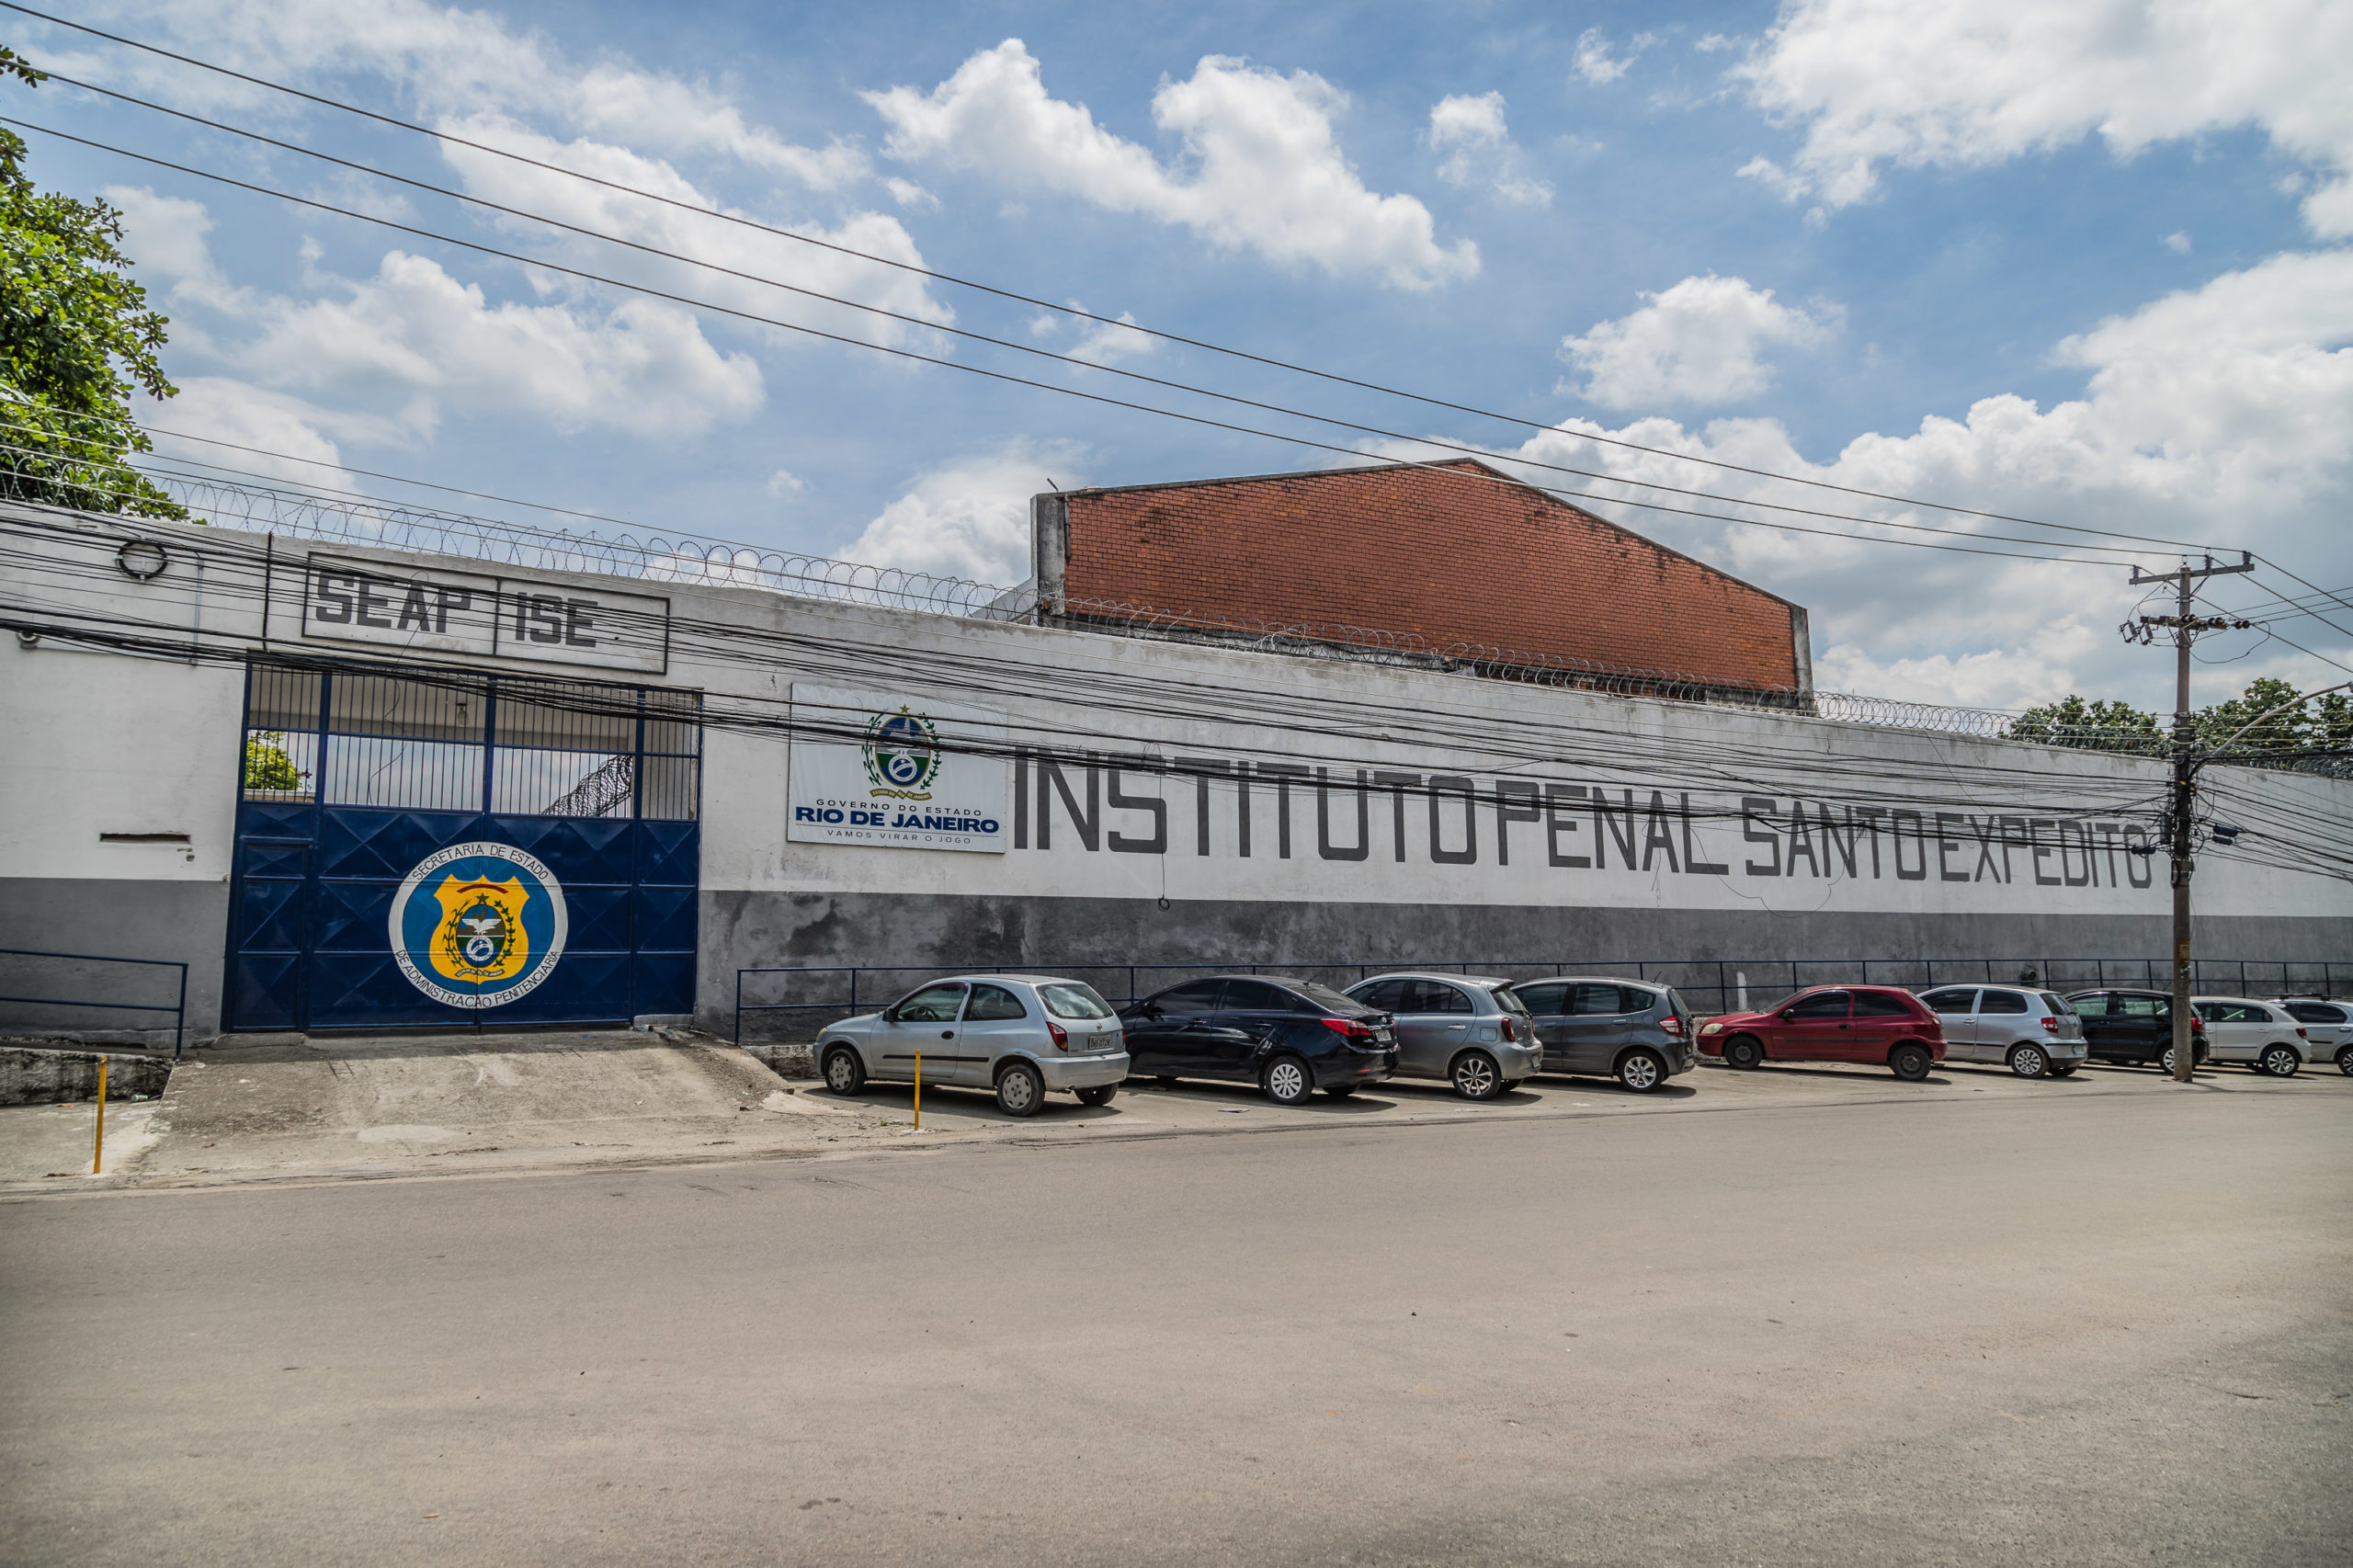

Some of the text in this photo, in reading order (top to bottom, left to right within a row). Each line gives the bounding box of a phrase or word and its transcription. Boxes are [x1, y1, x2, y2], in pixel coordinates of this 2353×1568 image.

[315, 571, 598, 647] SEAP ISE
[795, 806, 999, 834] RIO DE JANEIRO
[816, 799, 982, 816] GOVERNO DO ESTADO
[1015, 746, 2152, 889] INSTITUTO PENAL SANTO EXPEDITO
[827, 829, 872, 838] VAMOS
[880, 833, 918, 841] VIRAR
[412, 844, 549, 881] SECRETARIA DE ESTADO
[395, 949, 410, 965] DE
